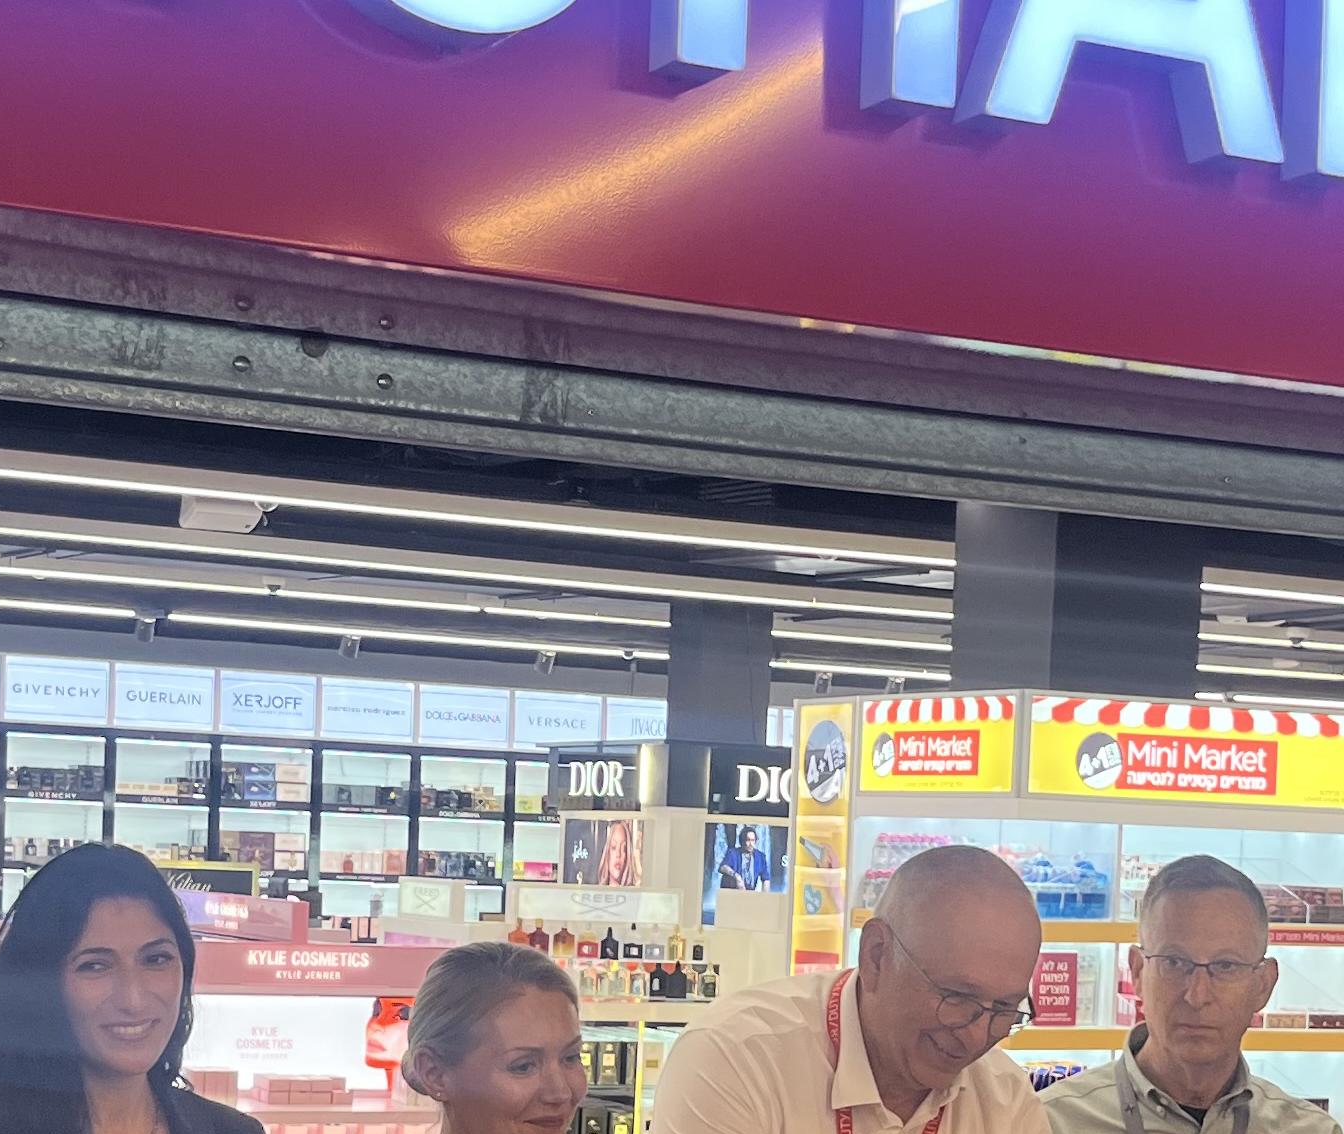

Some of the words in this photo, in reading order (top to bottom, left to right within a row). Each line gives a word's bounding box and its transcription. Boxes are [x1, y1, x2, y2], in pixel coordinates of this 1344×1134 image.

[11, 682, 101, 698] GIVENCHY
[126, 689, 202, 705] GUERLAIN
[232, 691, 304, 710] XERJOFF
[528, 716, 587, 730] VERSACE
[899, 736, 926, 757] Mini
[928, 735, 973, 757] Market
[1127, 739, 1179, 768] Mini
[1184, 742, 1268, 773] Market
[568, 760, 625, 798] DIOR
[1126, 770, 1175, 787] לנסיעה
[1219, 775, 1268, 790] מוצרים
[28, 791, 78, 800] GIVENCHY
[247, 949, 287, 966] KYLIE
[291, 951, 371, 968] COSMETICS
[1041, 959, 1055, 971] לא
[1056, 961, 1068, 971] נא
[275, 970, 302, 980] KYLIE
[304, 971, 342, 981] JENNER
[1040, 972, 1070, 983] לפתוח
[1039, 984, 1070, 995] מוצרים
[251, 1026, 279, 1037] KYLIE
[235, 1038, 294, 1050] COSMETICS
